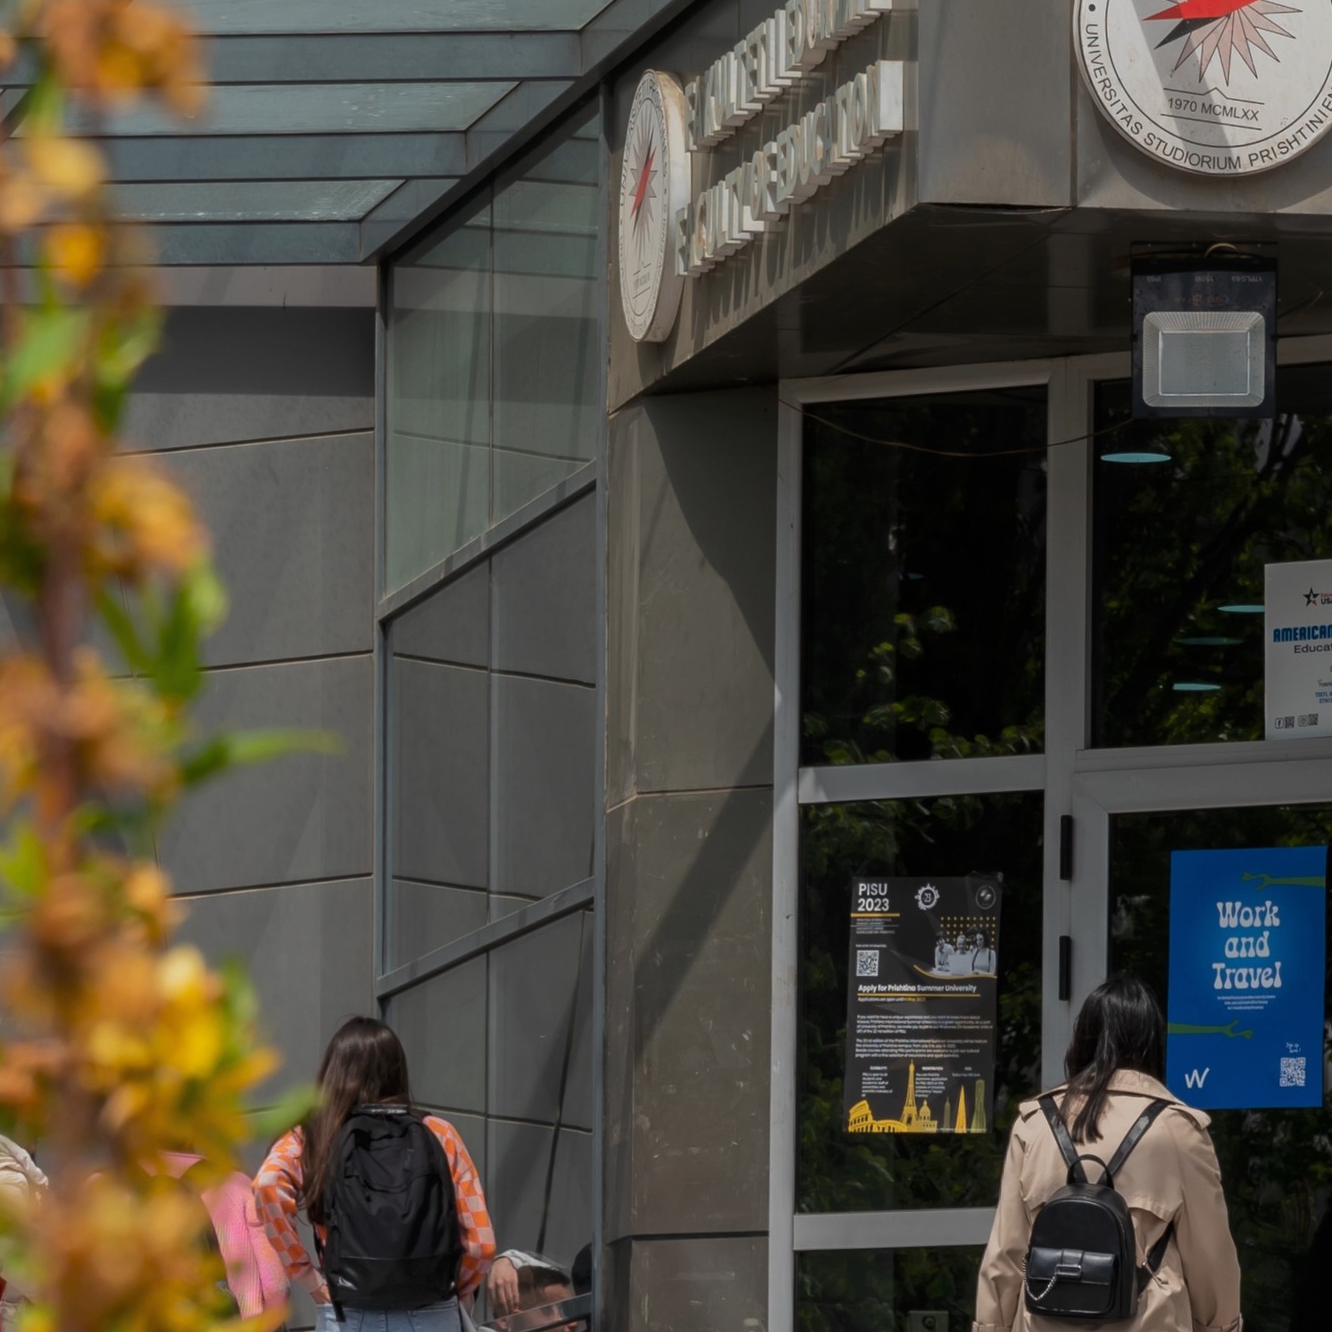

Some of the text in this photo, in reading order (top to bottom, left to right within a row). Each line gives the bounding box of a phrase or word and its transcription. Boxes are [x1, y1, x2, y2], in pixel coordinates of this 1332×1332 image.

[1085, 23, 1144, 136] UNIVERSITAS
[1142, 131, 1242, 171] STUDIORIUM
[1167, 96, 1260, 122] 1970 MCMLXX
[858, 883, 888, 896] PISU
[857, 898, 890, 912] 2023
[1216, 900, 1281, 928] Work
[1224, 930, 1271, 958] and
[1212, 961, 1282, 989] Travel
[858, 984, 877, 993] Apply
[887, 984, 916, 992] Prishtina
[917, 984, 944, 992] Summer
[945, 984, 977, 993] University
[1184, 1067, 1210, 1088] W
